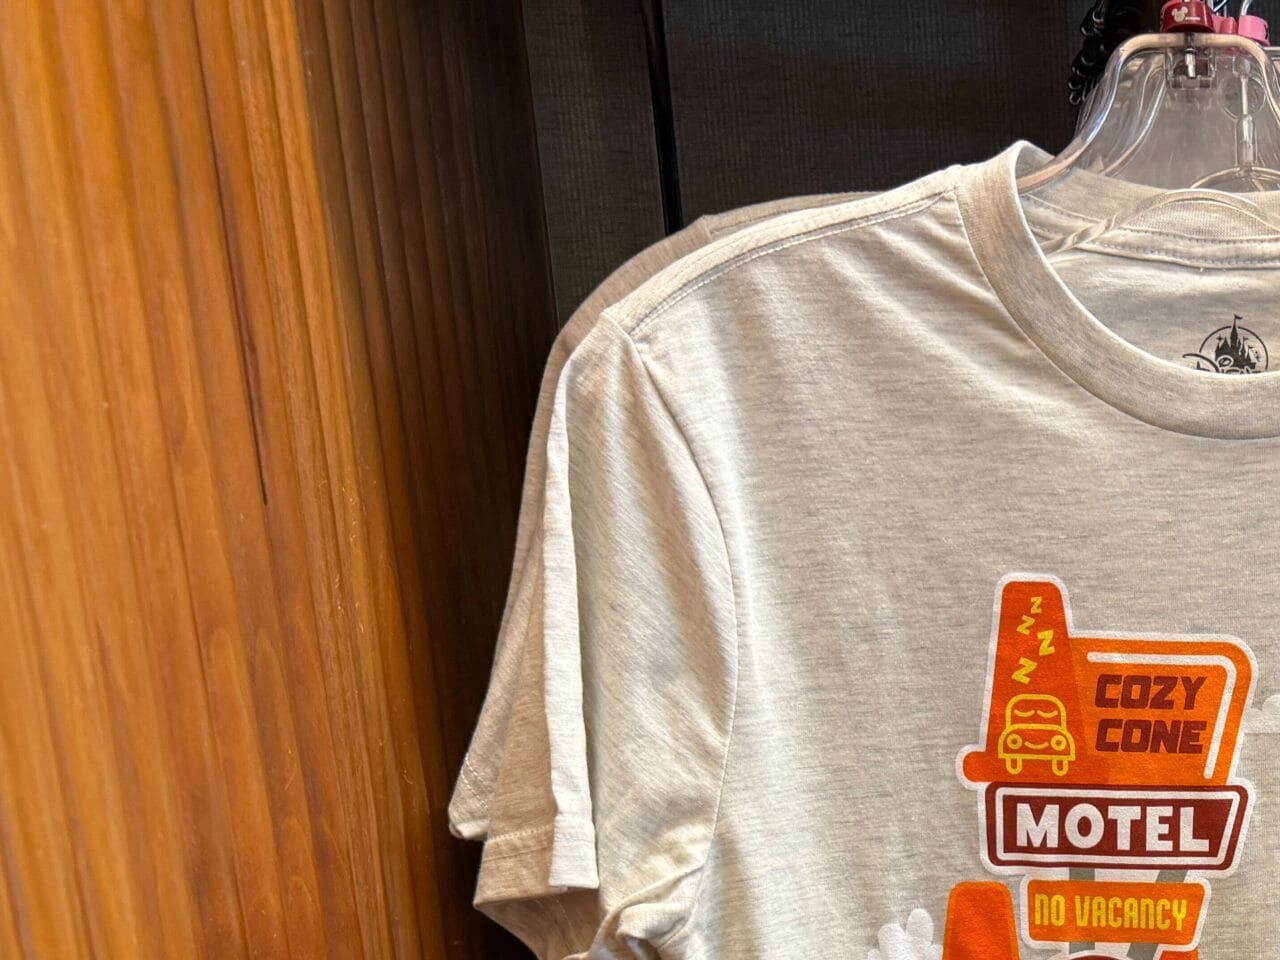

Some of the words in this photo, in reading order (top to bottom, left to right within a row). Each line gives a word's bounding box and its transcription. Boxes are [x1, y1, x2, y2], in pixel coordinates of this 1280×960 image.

[1095, 674, 1207, 710] COZY
[1095, 719, 1207, 754] CONE
[1016, 803, 1209, 852] MOTEL
[1034, 894, 1066, 927] NO
[1074, 896, 1188, 931] VACANCY
